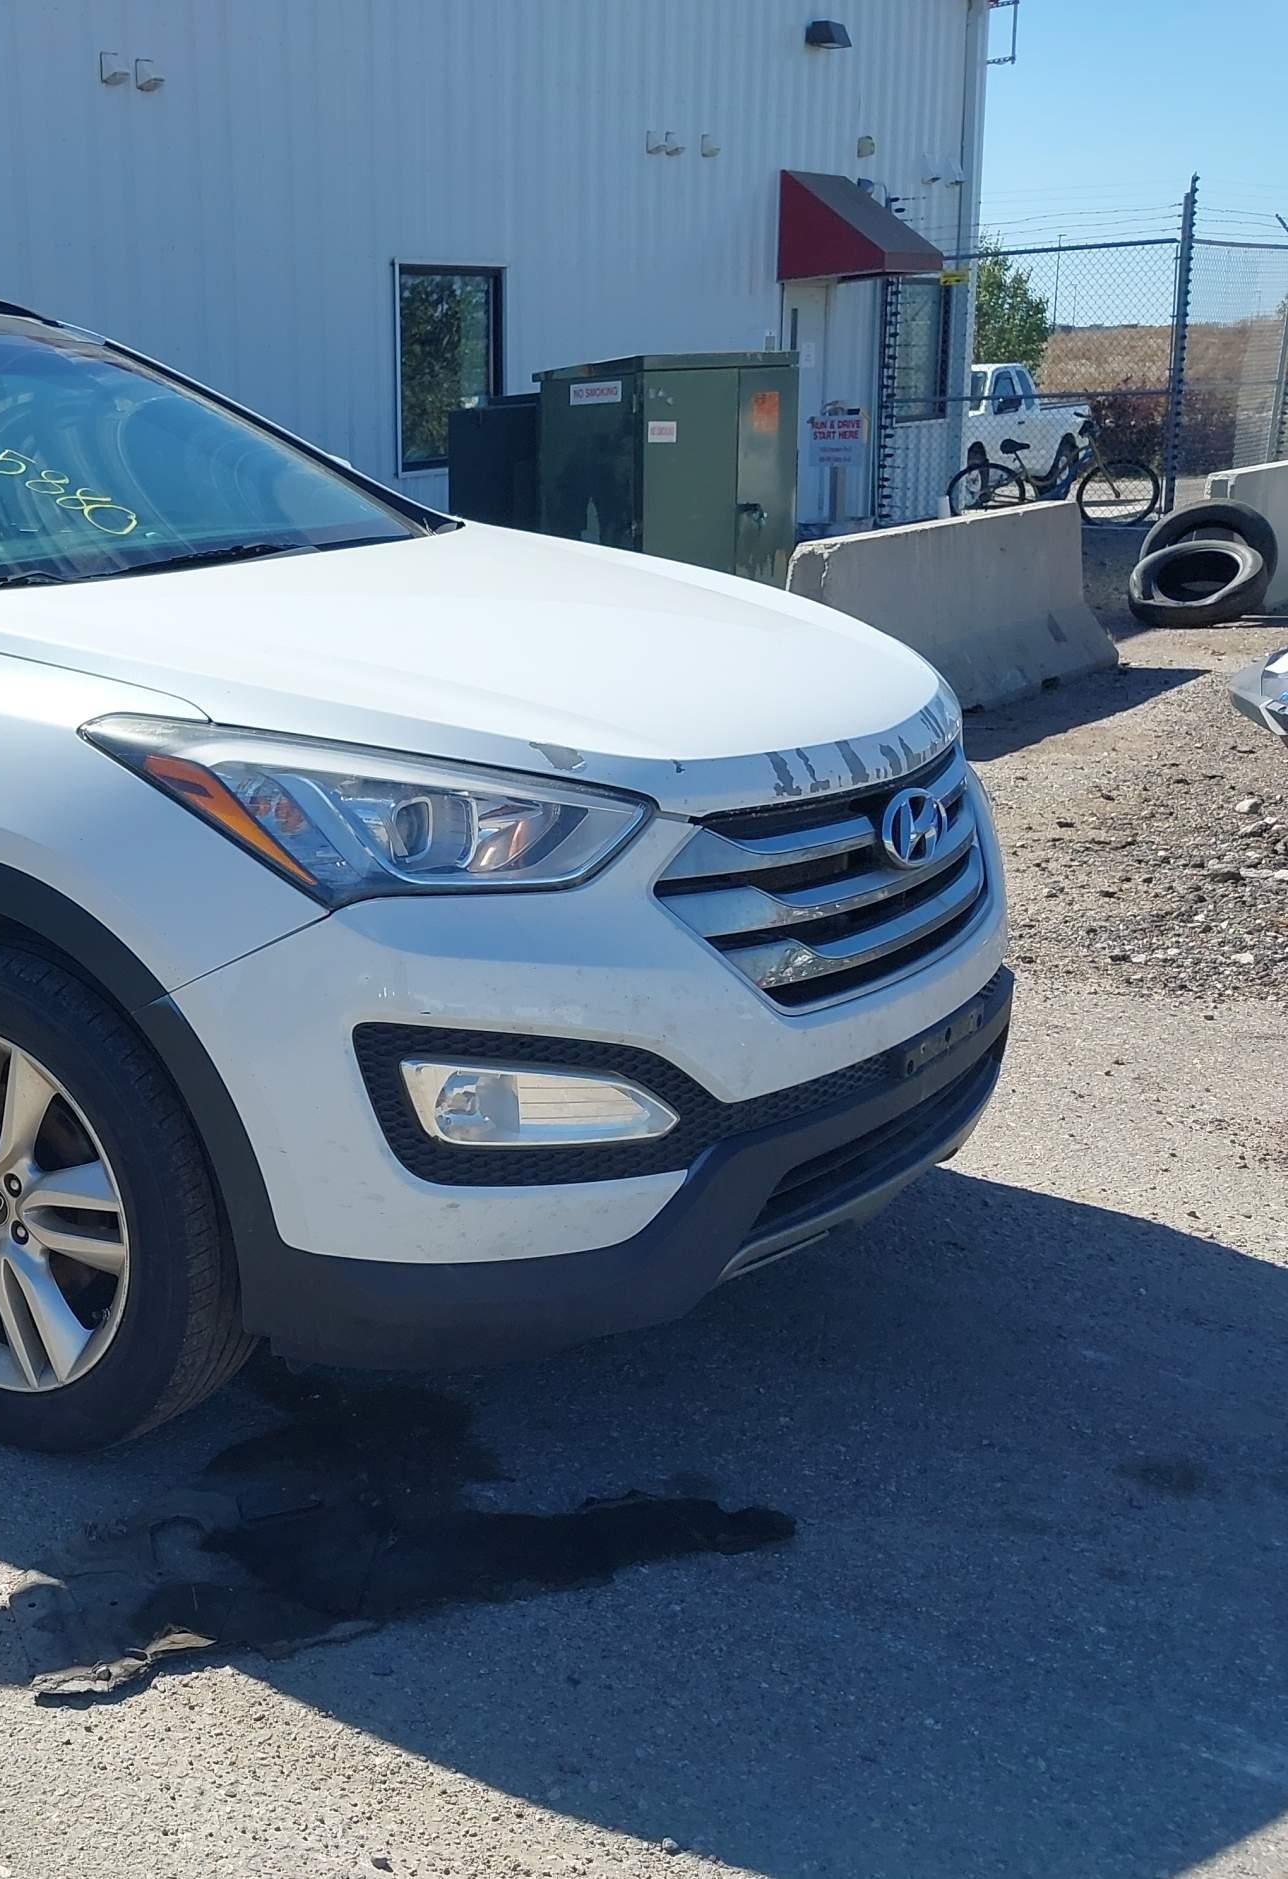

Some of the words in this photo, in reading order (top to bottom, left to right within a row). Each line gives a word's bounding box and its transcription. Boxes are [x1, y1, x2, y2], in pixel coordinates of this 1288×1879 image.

[573, 388, 585, 400] NO
[585, 386, 617, 398] SMOKING
[837, 419, 860, 429] DRIVE
[813, 431, 836, 440] START
[838, 430, 859, 440] HERE
